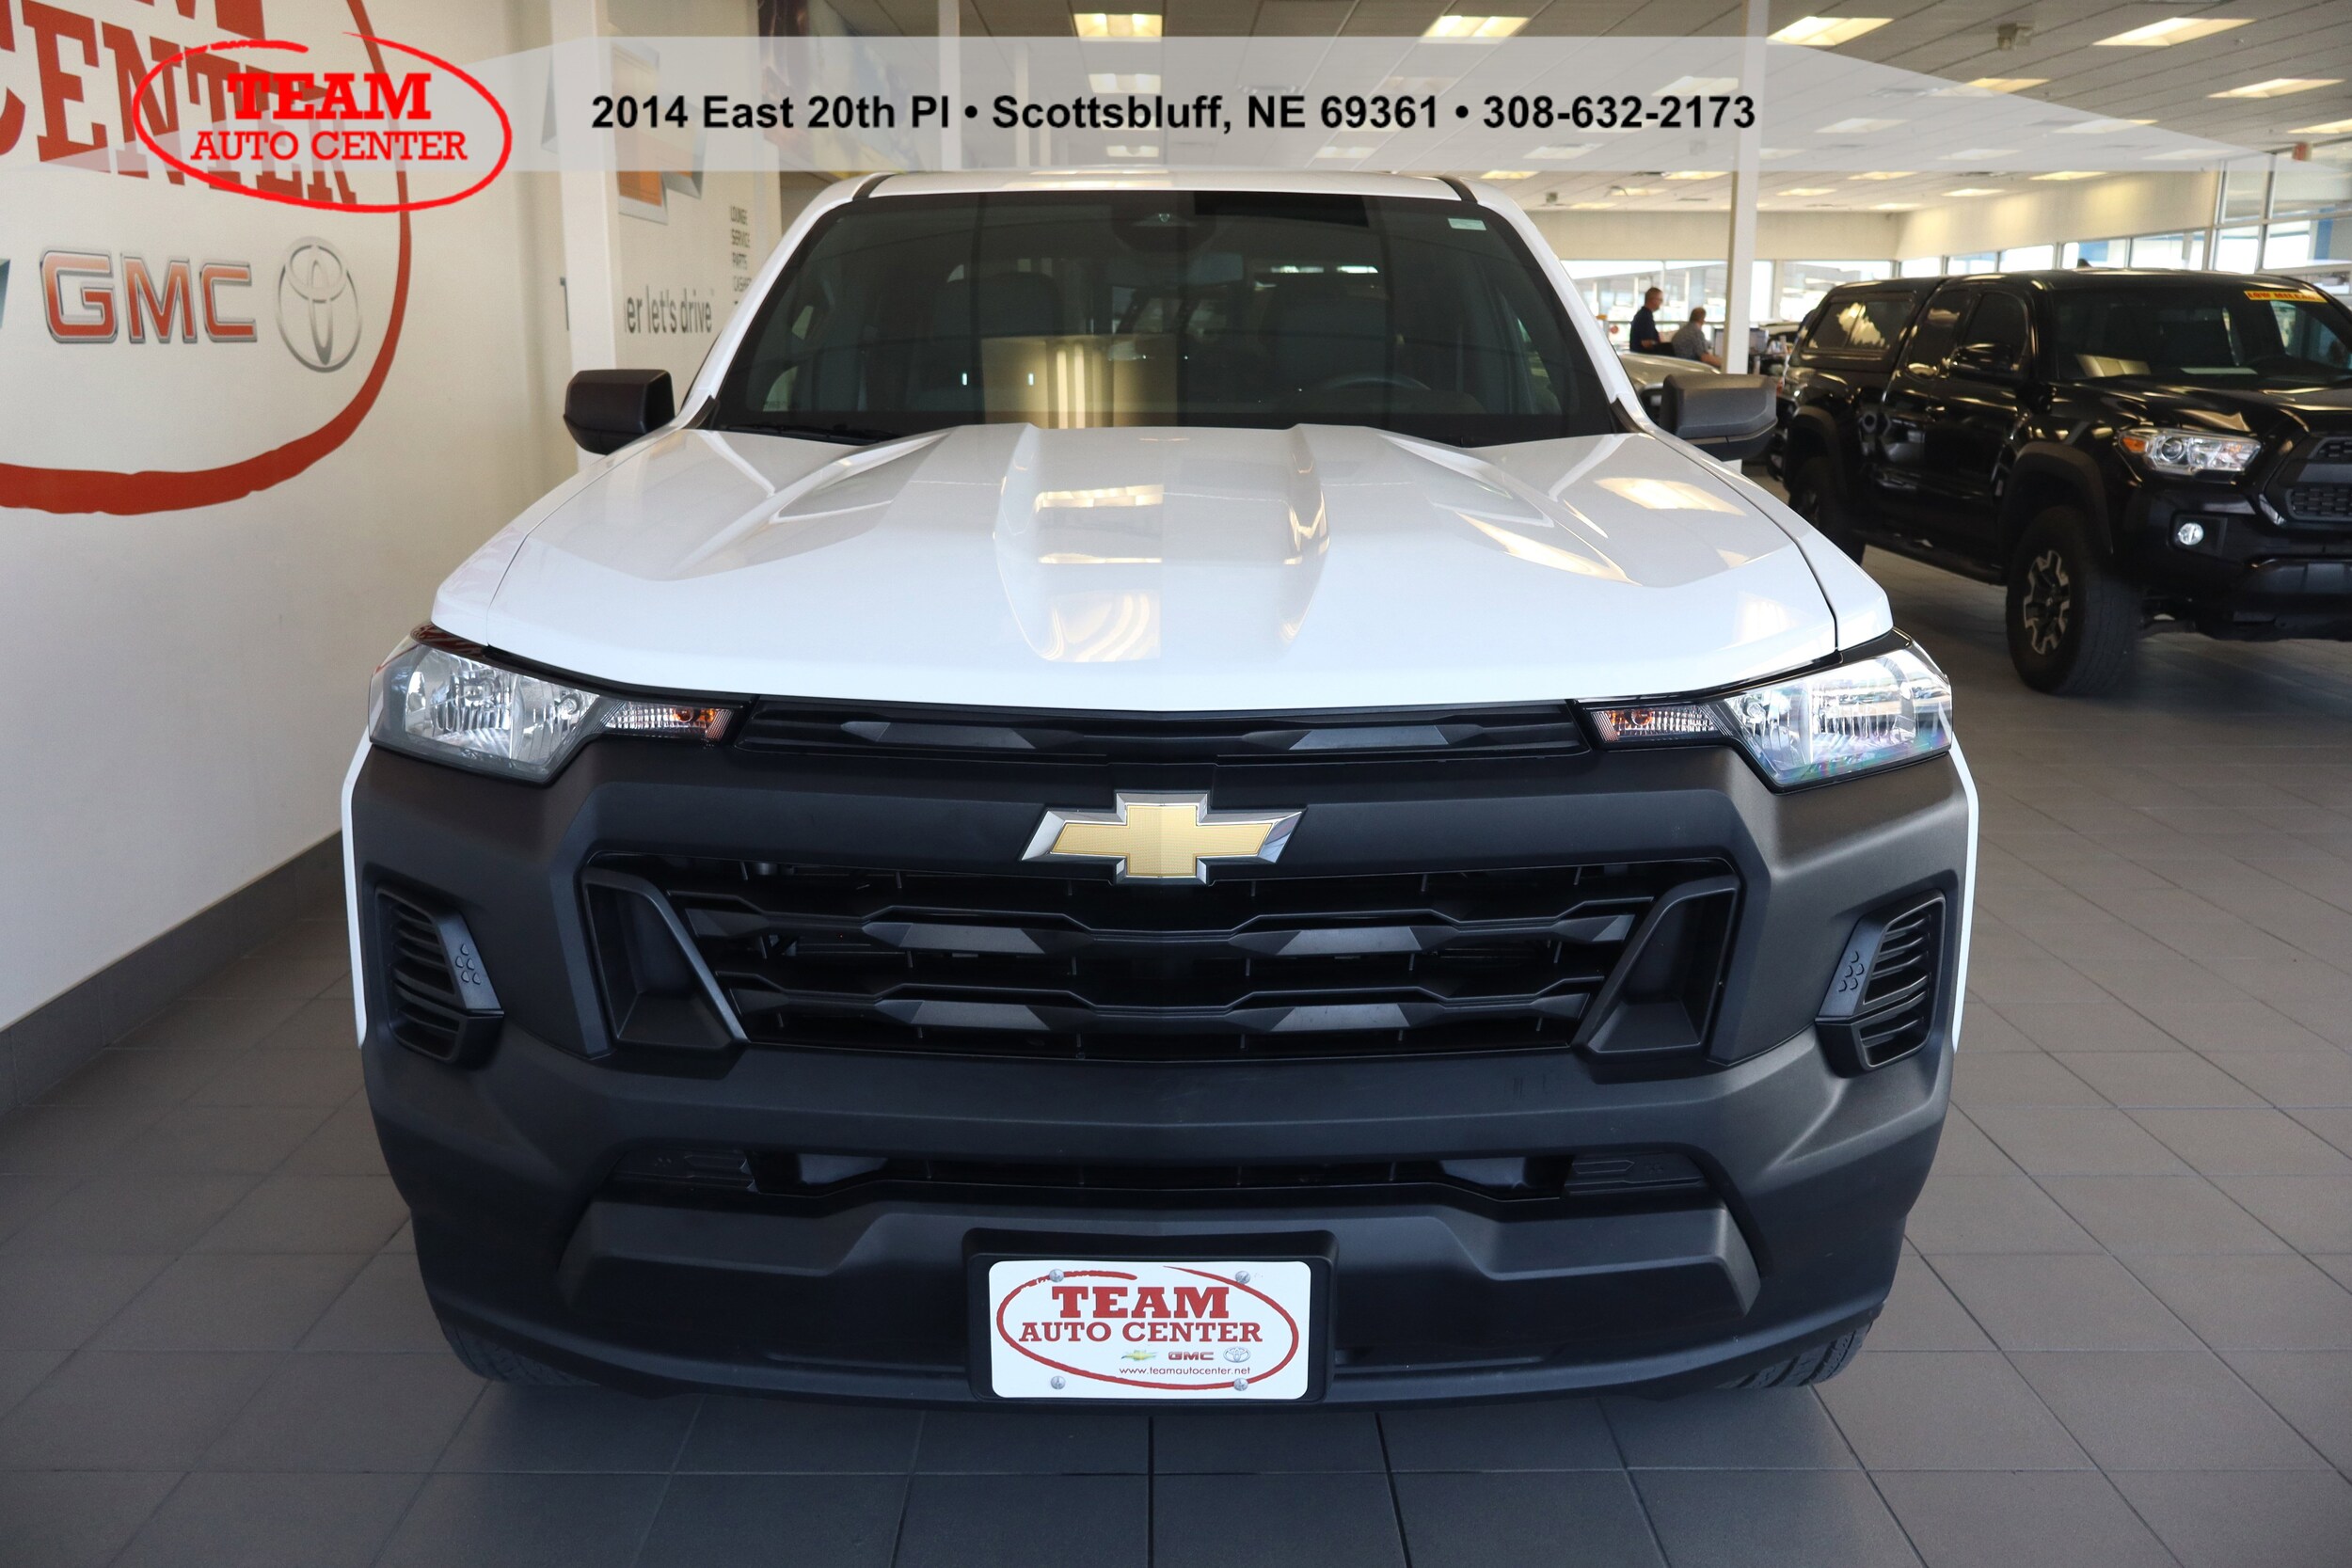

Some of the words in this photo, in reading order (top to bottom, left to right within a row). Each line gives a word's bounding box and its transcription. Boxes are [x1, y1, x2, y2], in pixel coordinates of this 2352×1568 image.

[0, 0, 358, 204] ENTER
[40, 248, 257, 343] GMC
[624, 295, 643, 334] er
[646, 284, 677, 334] let's
[680, 288, 712, 334] drive
[1052, 1286, 1229, 1319] TEAM
[1019, 1322, 1111, 1342] AUTO
[1122, 1322, 1263, 1343] CENTER
[1119, 1367, 1251, 1375] www.teamautocenter.net
[1168, 1352, 1215, 1361] GMC
